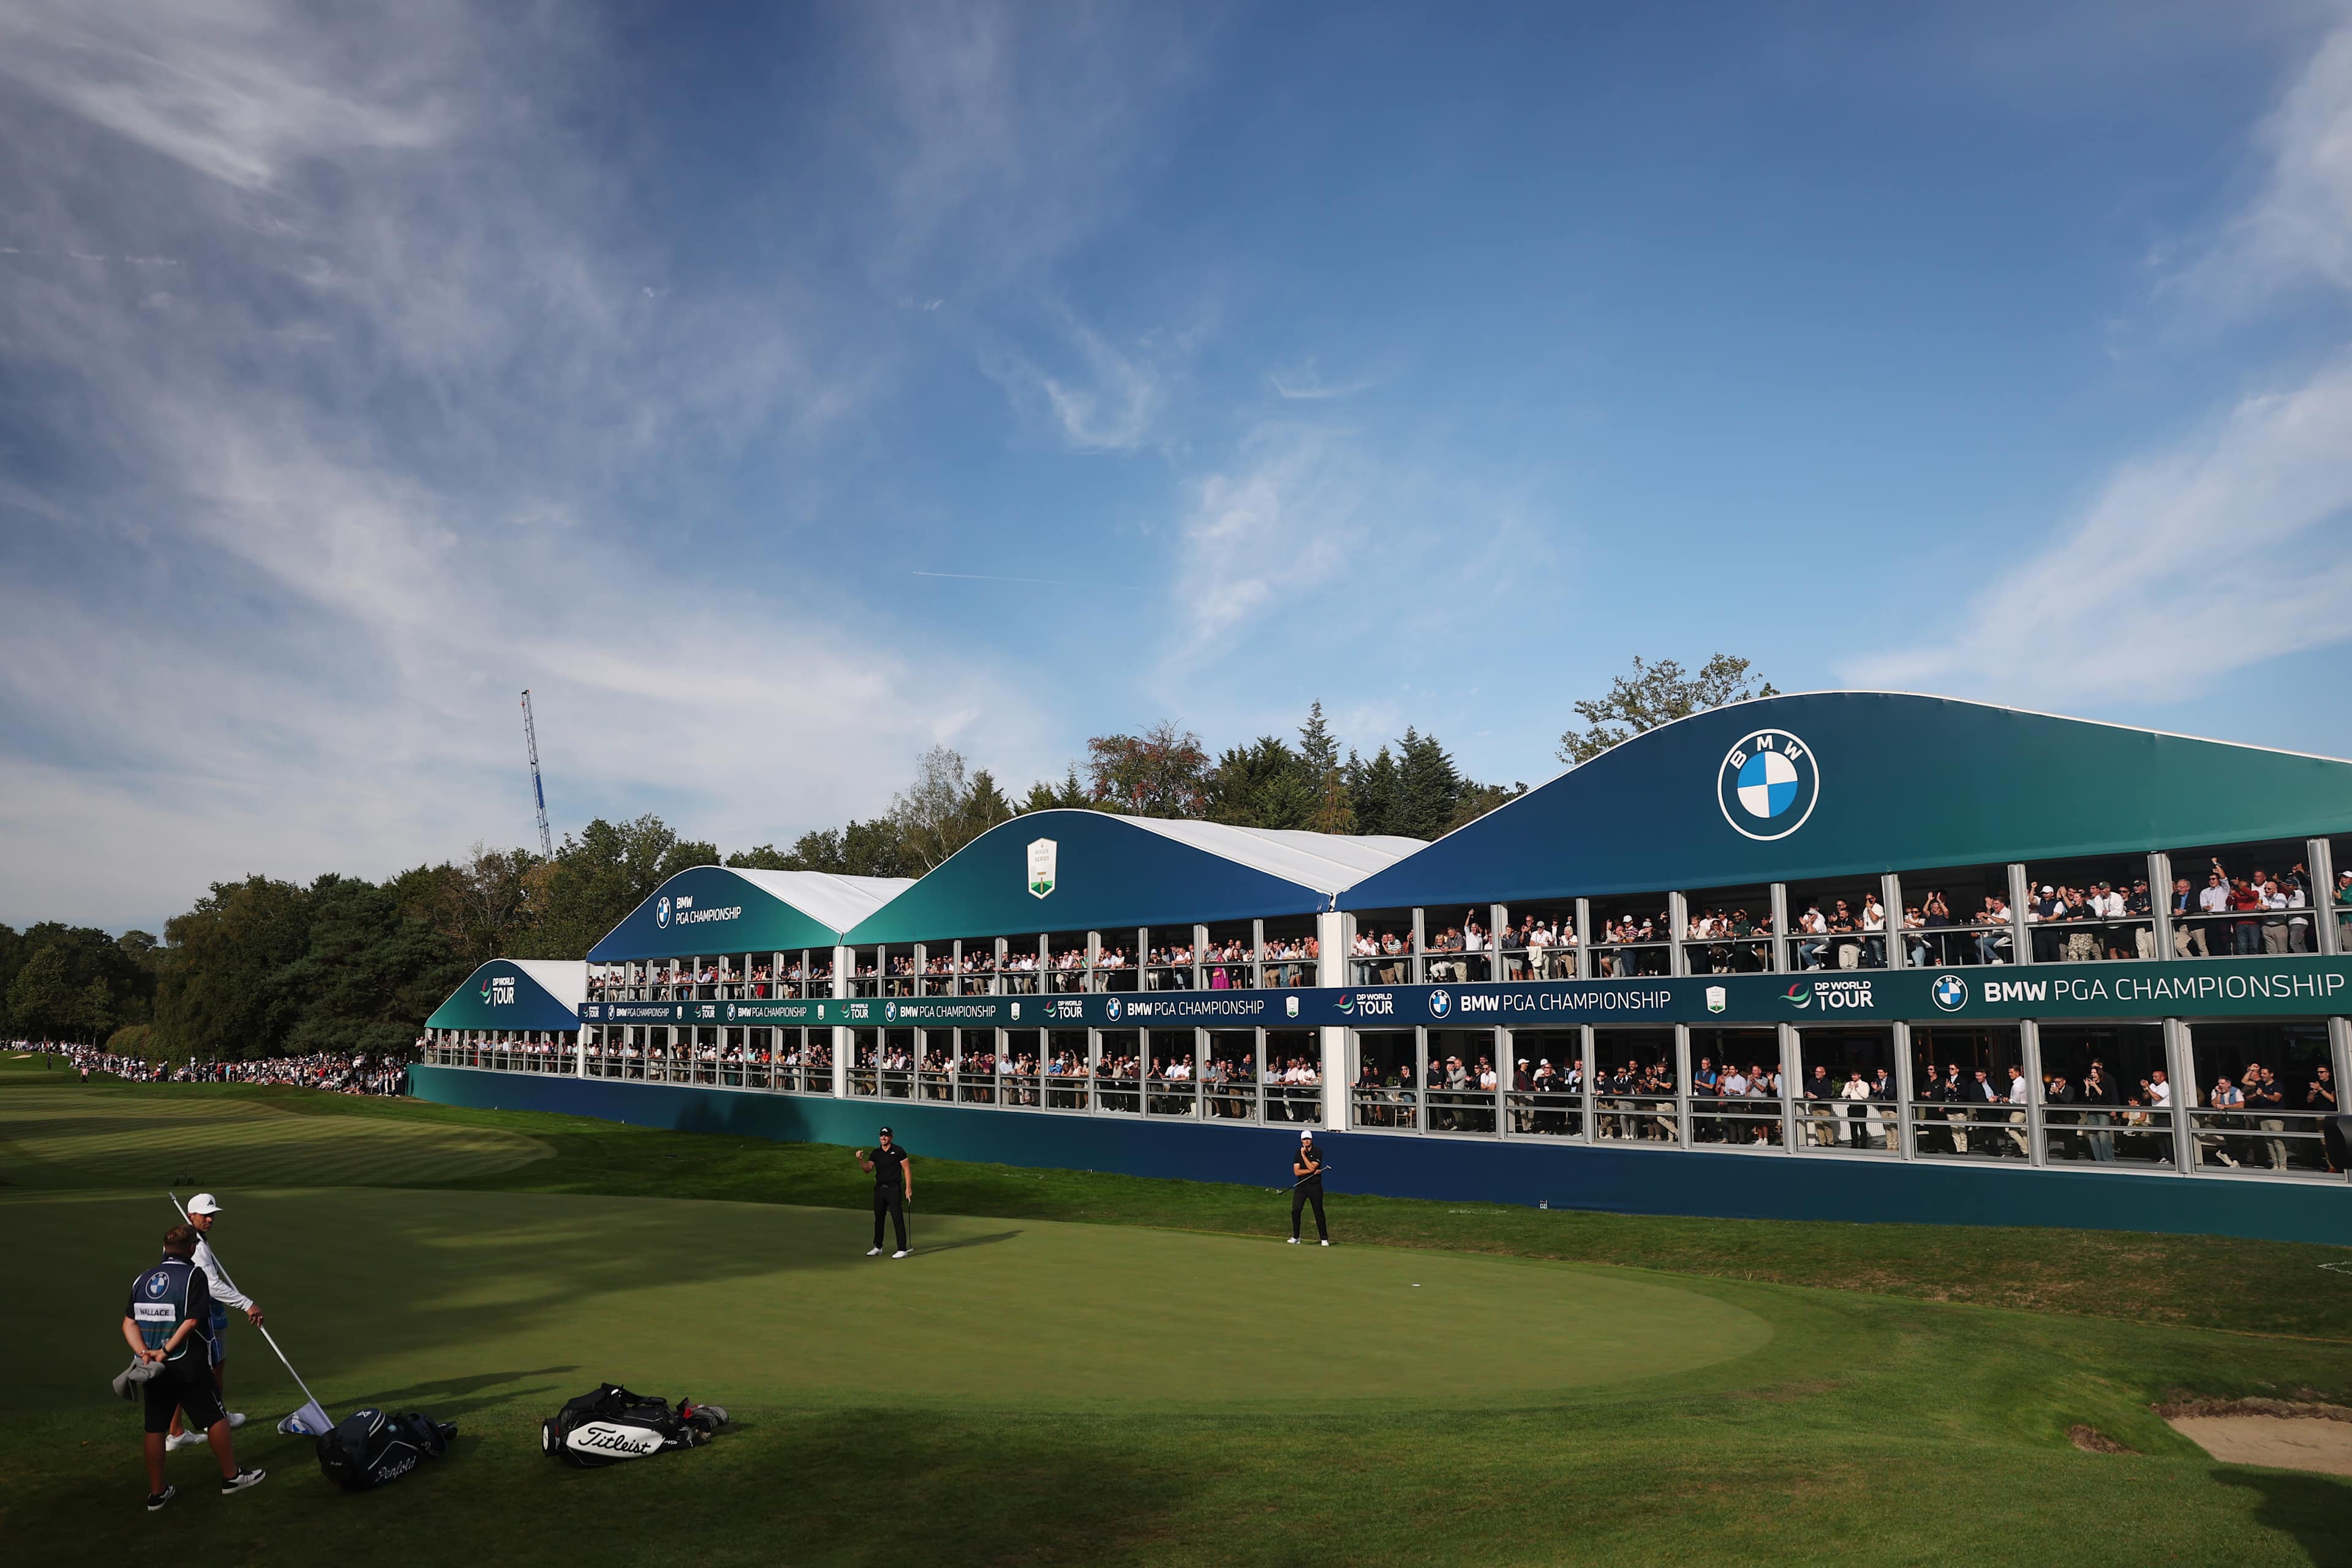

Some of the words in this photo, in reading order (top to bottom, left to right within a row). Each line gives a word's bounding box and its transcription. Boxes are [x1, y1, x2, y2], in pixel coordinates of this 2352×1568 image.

[1729, 734, 1803, 770] BMW
[676, 895, 693, 909] BMW
[676, 912, 689, 925] PGA
[690, 907, 741, 923] CHAMPIONSHIP
[499, 977, 514, 986] WORLD
[1814, 982, 1830, 990] DP
[1830, 981, 1871, 990] WORLD
[1936, 977, 1962, 987] BMW
[1984, 981, 2046, 1002] BMW
[2054, 979, 2108, 1001] PGA
[2115, 974, 2345, 1000] CHAMPIONSHIP
[492, 986, 514, 1008] TOUR
[1461, 995, 1499, 1011] BMW
[1503, 994, 1536, 1011] PGA
[1540, 991, 1671, 1011] CHAMPIONSHIP
[1815, 990, 1874, 1011] TOUR
[627, 1008, 636, 1017] PGA
[636, 1008, 669, 1017] CHAMPIONSHIP
[702, 1009, 715, 1019] TOUR
[737, 1008, 752, 1017] BMW
[752, 1007, 763, 1017] PGA
[764, 1006, 807, 1017] CHAMPIONSHIP
[851, 1009, 869, 1020] TOUR
[900, 1006, 918, 1017] BMW
[919, 1006, 935, 1017] PGA
[936, 1005, 996, 1017] CHAMPIONSHIP
[1058, 1006, 1083, 1019] TOUR
[1127, 1003, 1152, 1016] BMW
[1155, 1002, 1176, 1016] PGA
[1178, 1000, 1264, 1016] CHAMPIONSHIP
[1357, 1001, 1394, 1017] TOUR
[578, 1427, 651, 1454] Titleist
[375, 1455, 417, 1482] Penfold
